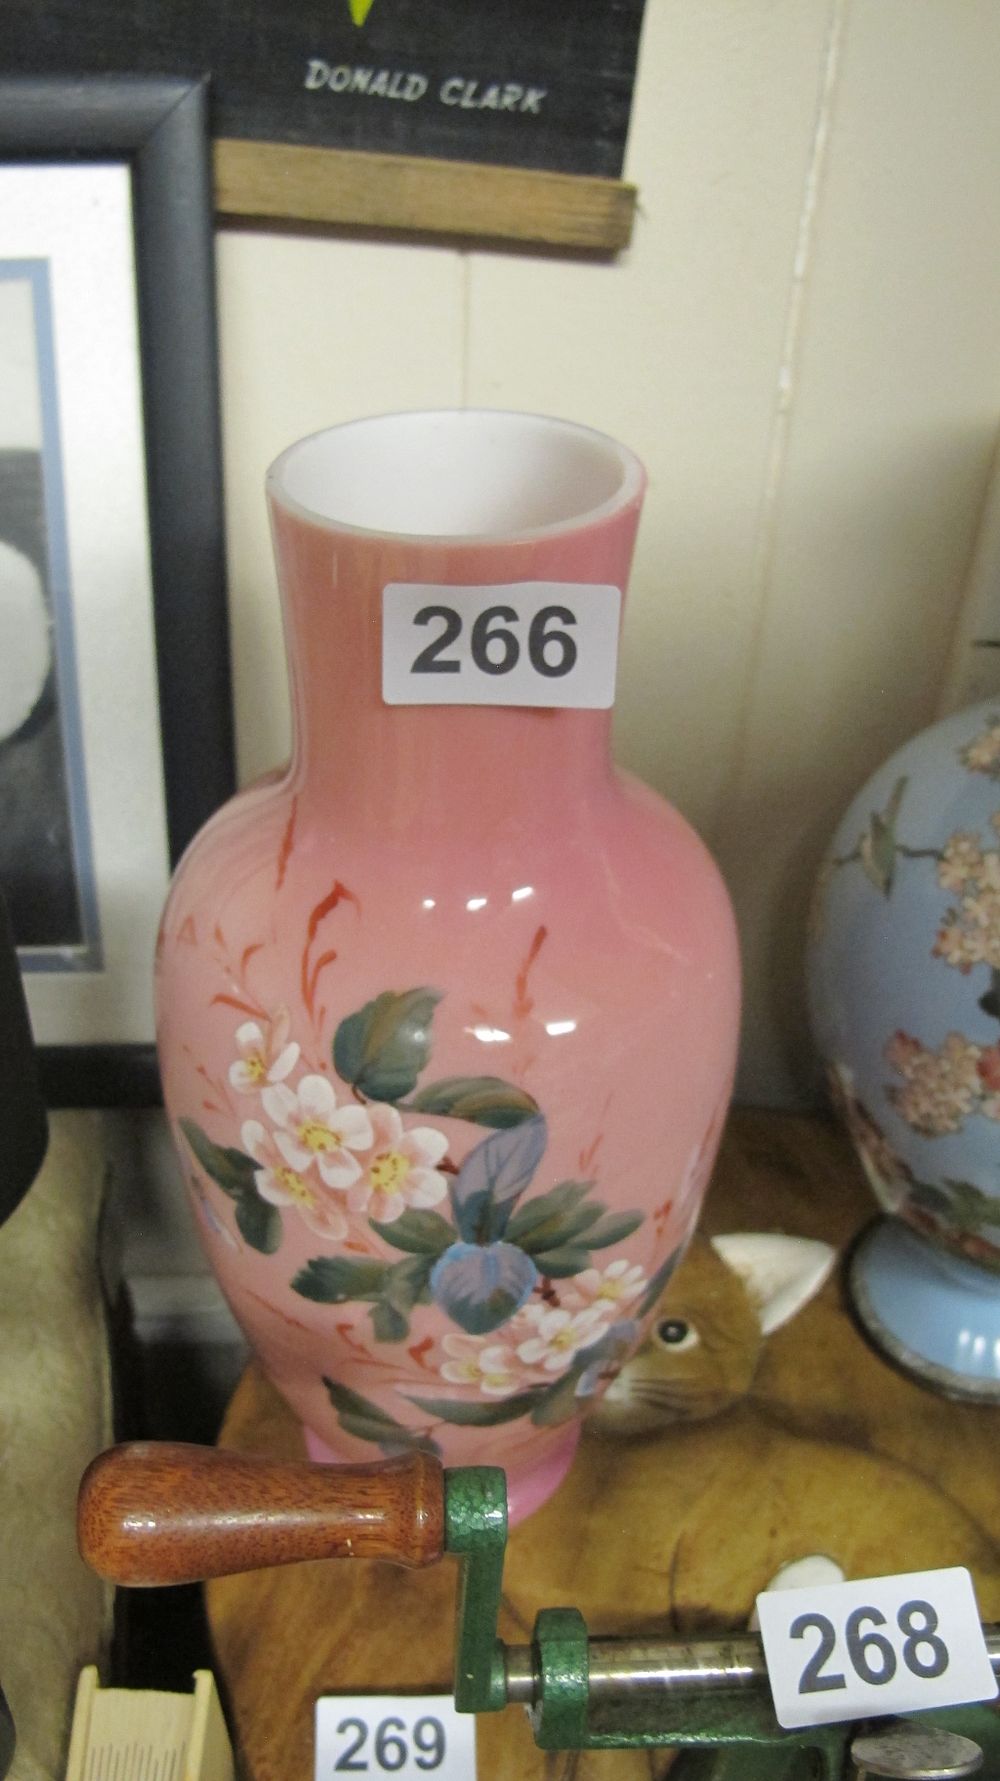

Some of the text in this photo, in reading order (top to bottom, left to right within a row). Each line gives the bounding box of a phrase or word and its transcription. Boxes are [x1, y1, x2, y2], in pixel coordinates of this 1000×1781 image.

[304, 59, 548, 114] DONALD CLARK
[410, 605, 578, 678] 266
[789, 1600, 949, 1694] 268
[334, 1716, 446, 1771] 269
